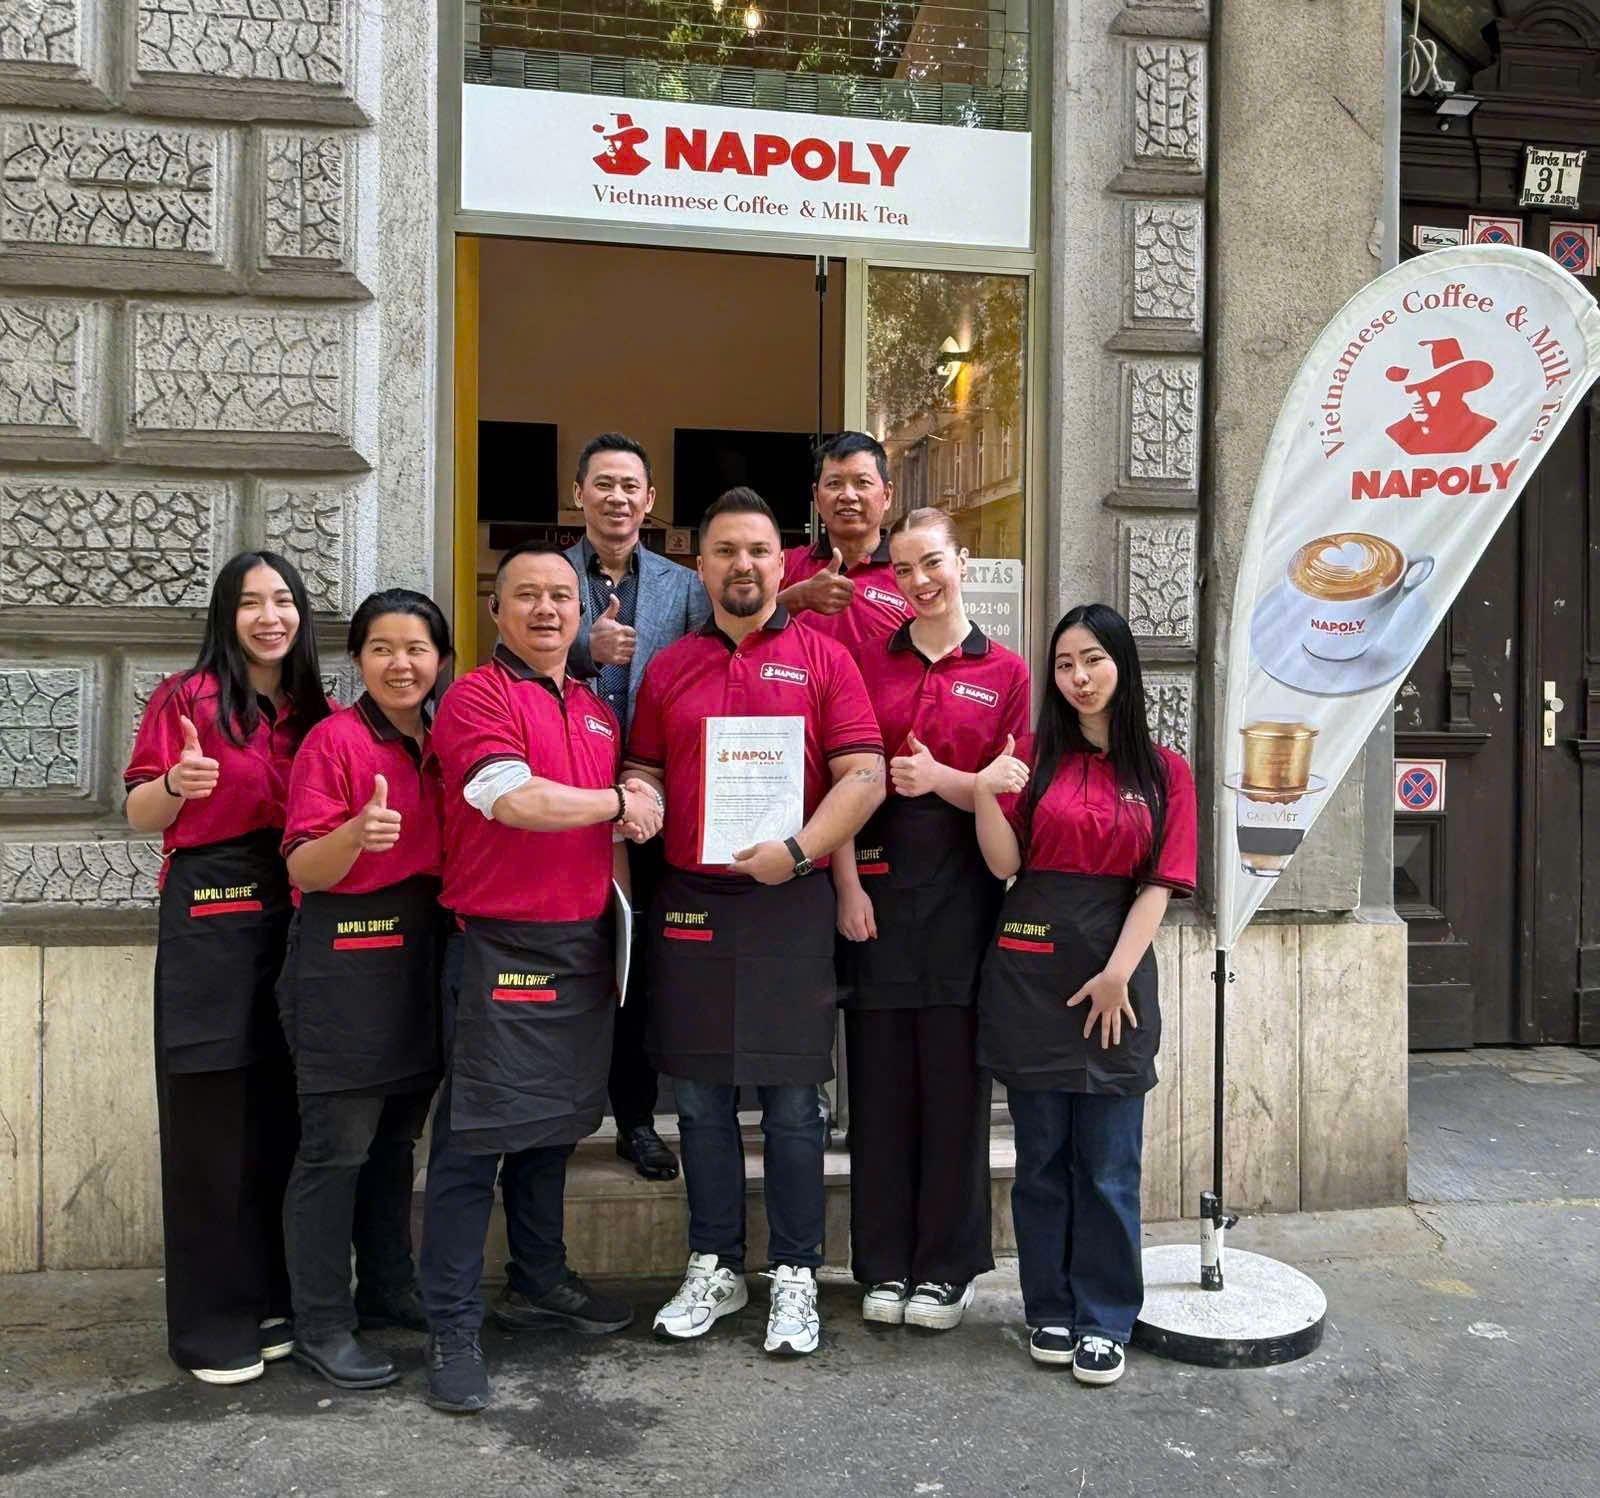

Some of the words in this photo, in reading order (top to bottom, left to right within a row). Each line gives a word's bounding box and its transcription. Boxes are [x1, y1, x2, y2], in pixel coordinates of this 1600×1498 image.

[664, 126, 911, 187] NAPOLY
[1537, 167, 1565, 194] 31
[592, 184, 719, 212] Vietnamese
[723, 194, 789, 217] Coffee
[800, 200, 817, 219] &
[822, 200, 869, 222] Milk
[874, 206, 910, 226] Tea
[1319, 308, 1398, 460] Vietnamese
[1402, 283, 1494, 315] Coffee
[1505, 305, 1528, 332] &
[1526, 325, 1571, 392] Milk
[1351, 458, 1521, 501] NAPOLY
[1311, 618, 1366, 632] NAPOLY
[774, 668, 805, 682] NAPOLY
[965, 687, 995, 703] NAPOLY
[732, 751, 784, 761] NAPOLY
[194, 887, 223, 901] NAPOLI
[337, 920, 366, 934] NAPOLI
